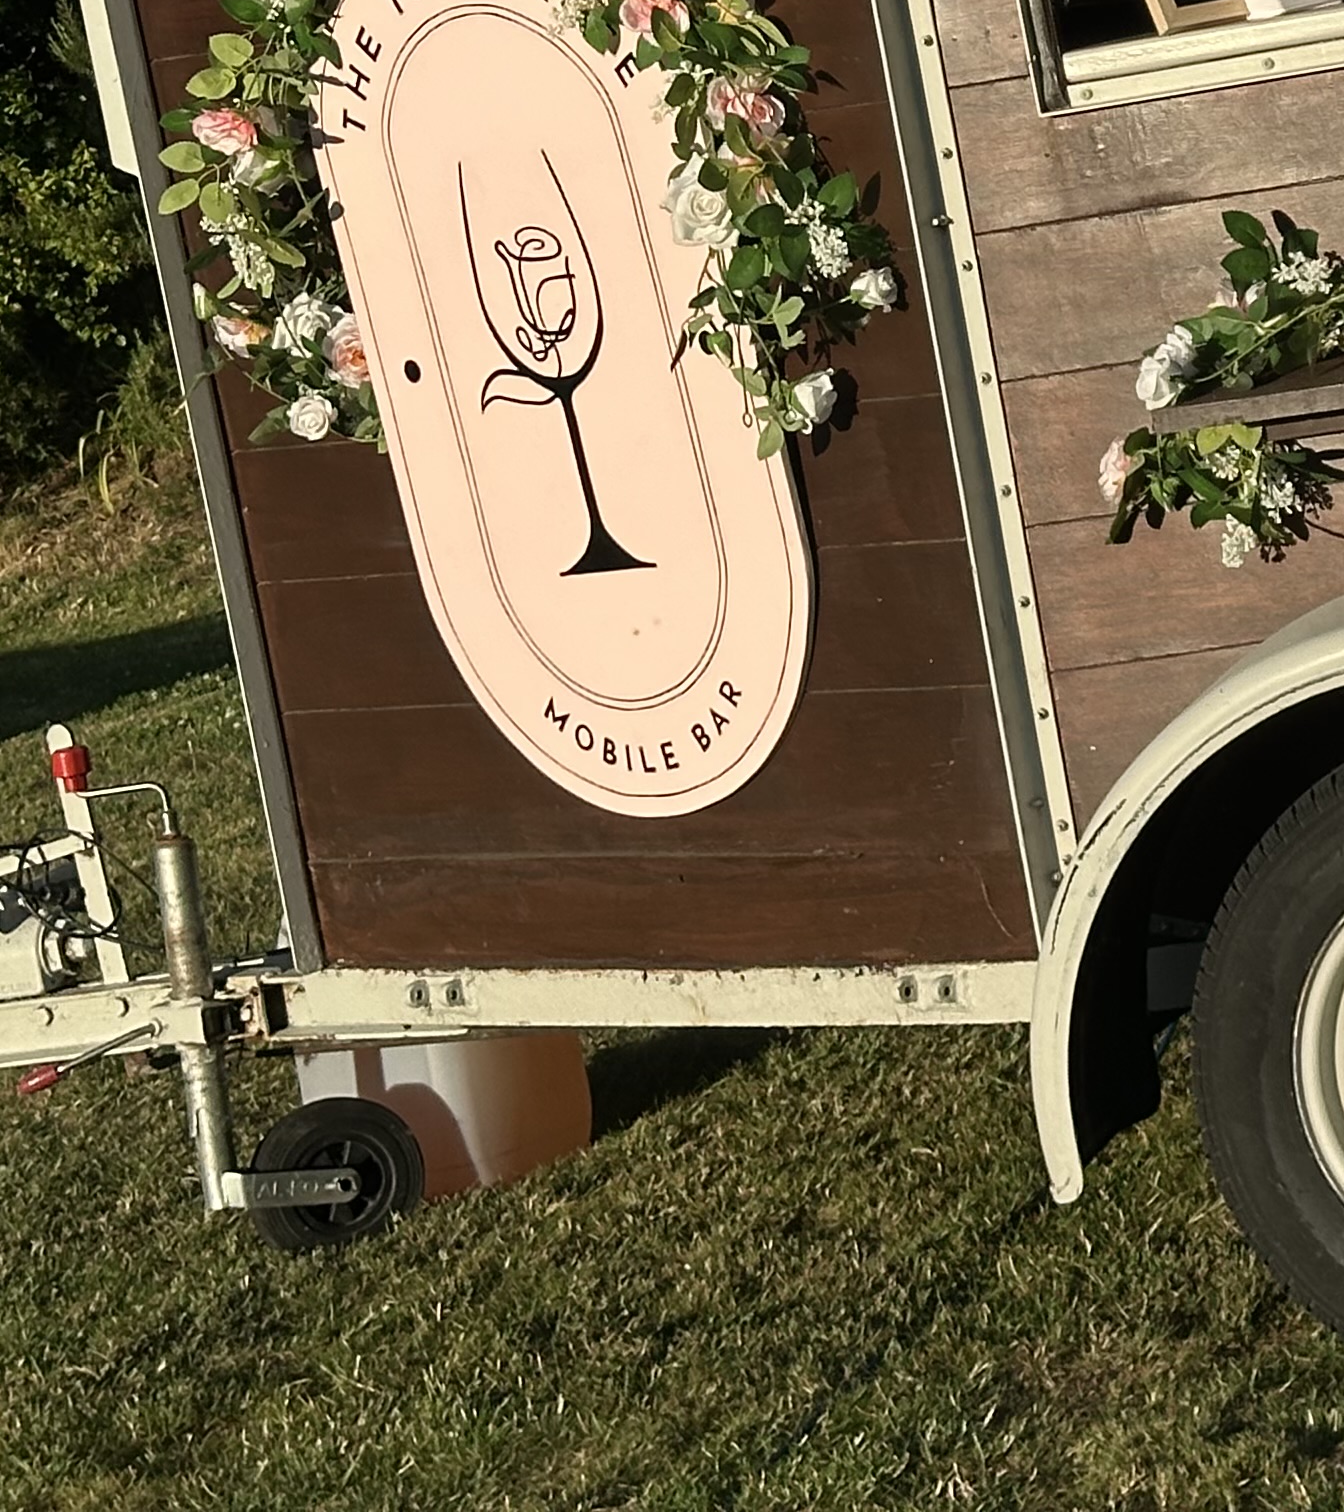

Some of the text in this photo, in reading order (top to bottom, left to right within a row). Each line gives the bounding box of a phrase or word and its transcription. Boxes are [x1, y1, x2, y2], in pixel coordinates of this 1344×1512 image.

[341, 25, 382, 132] THE
[543, 680, 743, 774] MOBILE BAR
